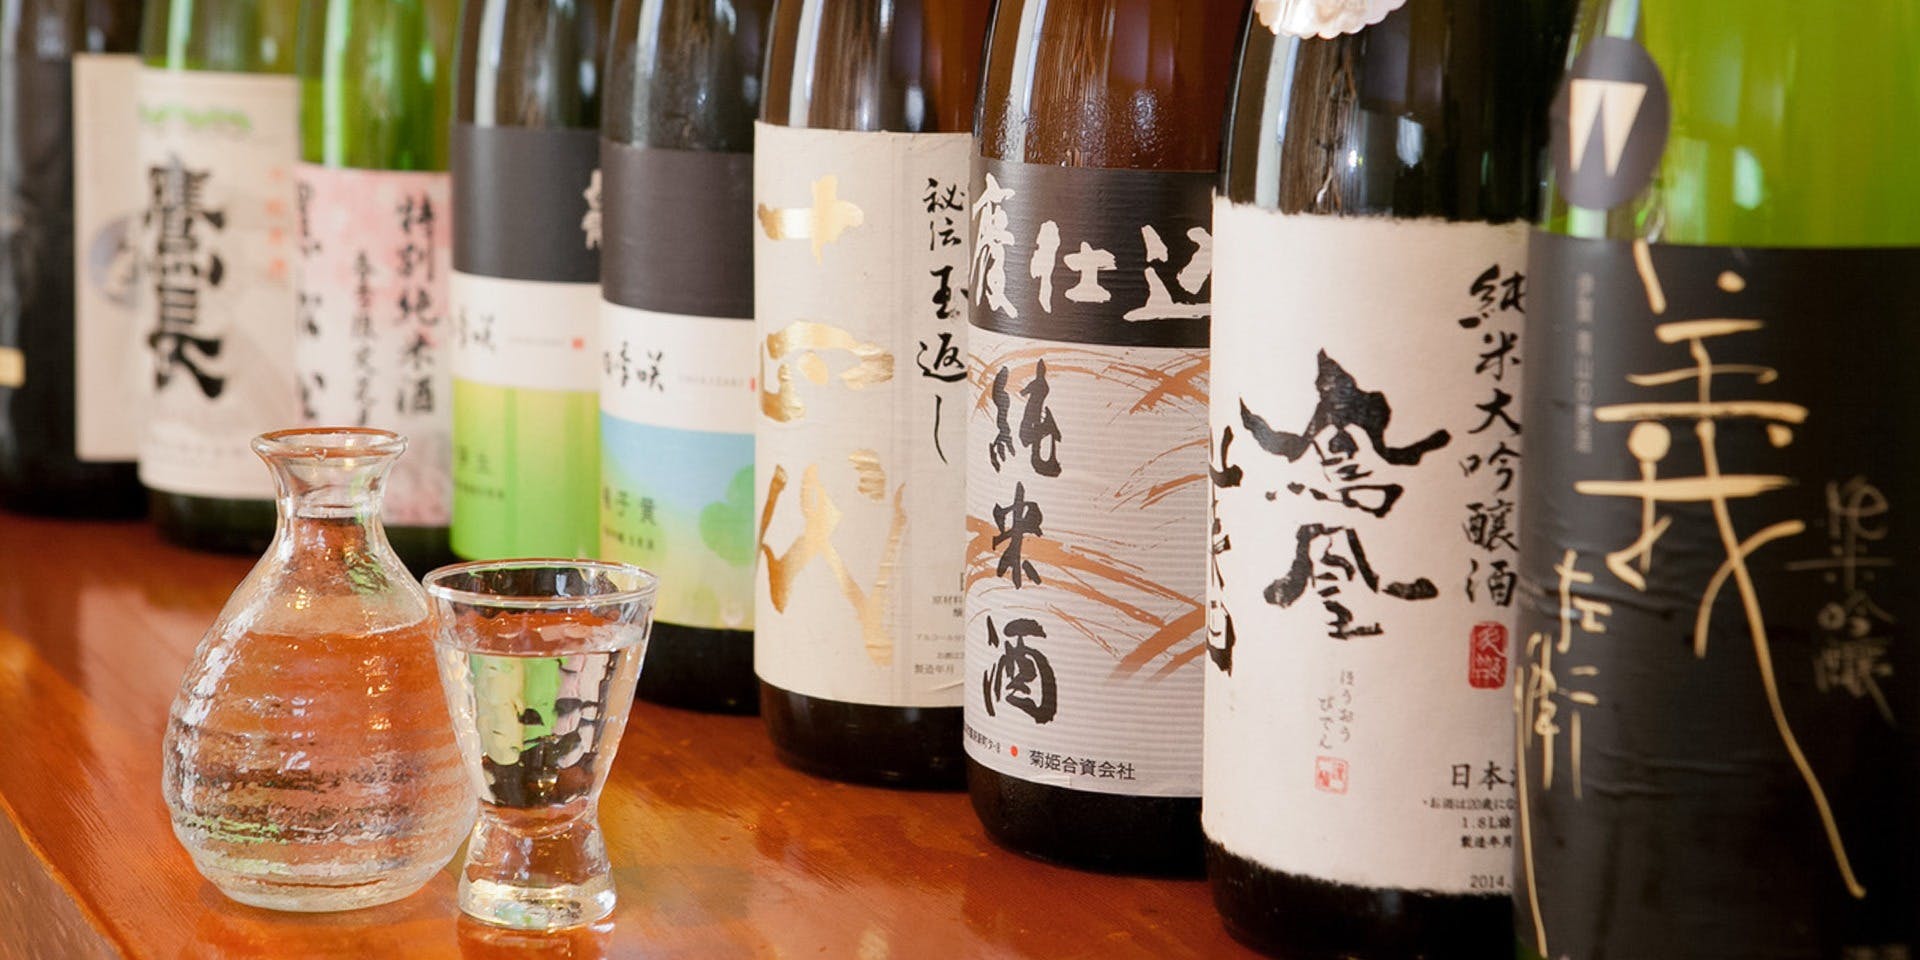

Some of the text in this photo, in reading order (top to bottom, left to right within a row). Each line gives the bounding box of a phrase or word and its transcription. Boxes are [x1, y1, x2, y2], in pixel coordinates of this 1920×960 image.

[757, 174, 907, 667] 十四代
[917, 178, 968, 464] 秘伝玉返し
[1457, 264, 1526, 608] 純米大吟醸酒
[983, 358, 1063, 724] 純米酒
[1241, 348, 1452, 639] 鳳凰
[1029, 748, 1137, 781] 菊姫合資会社
[1339, 669, 1355, 743] ほうおう
